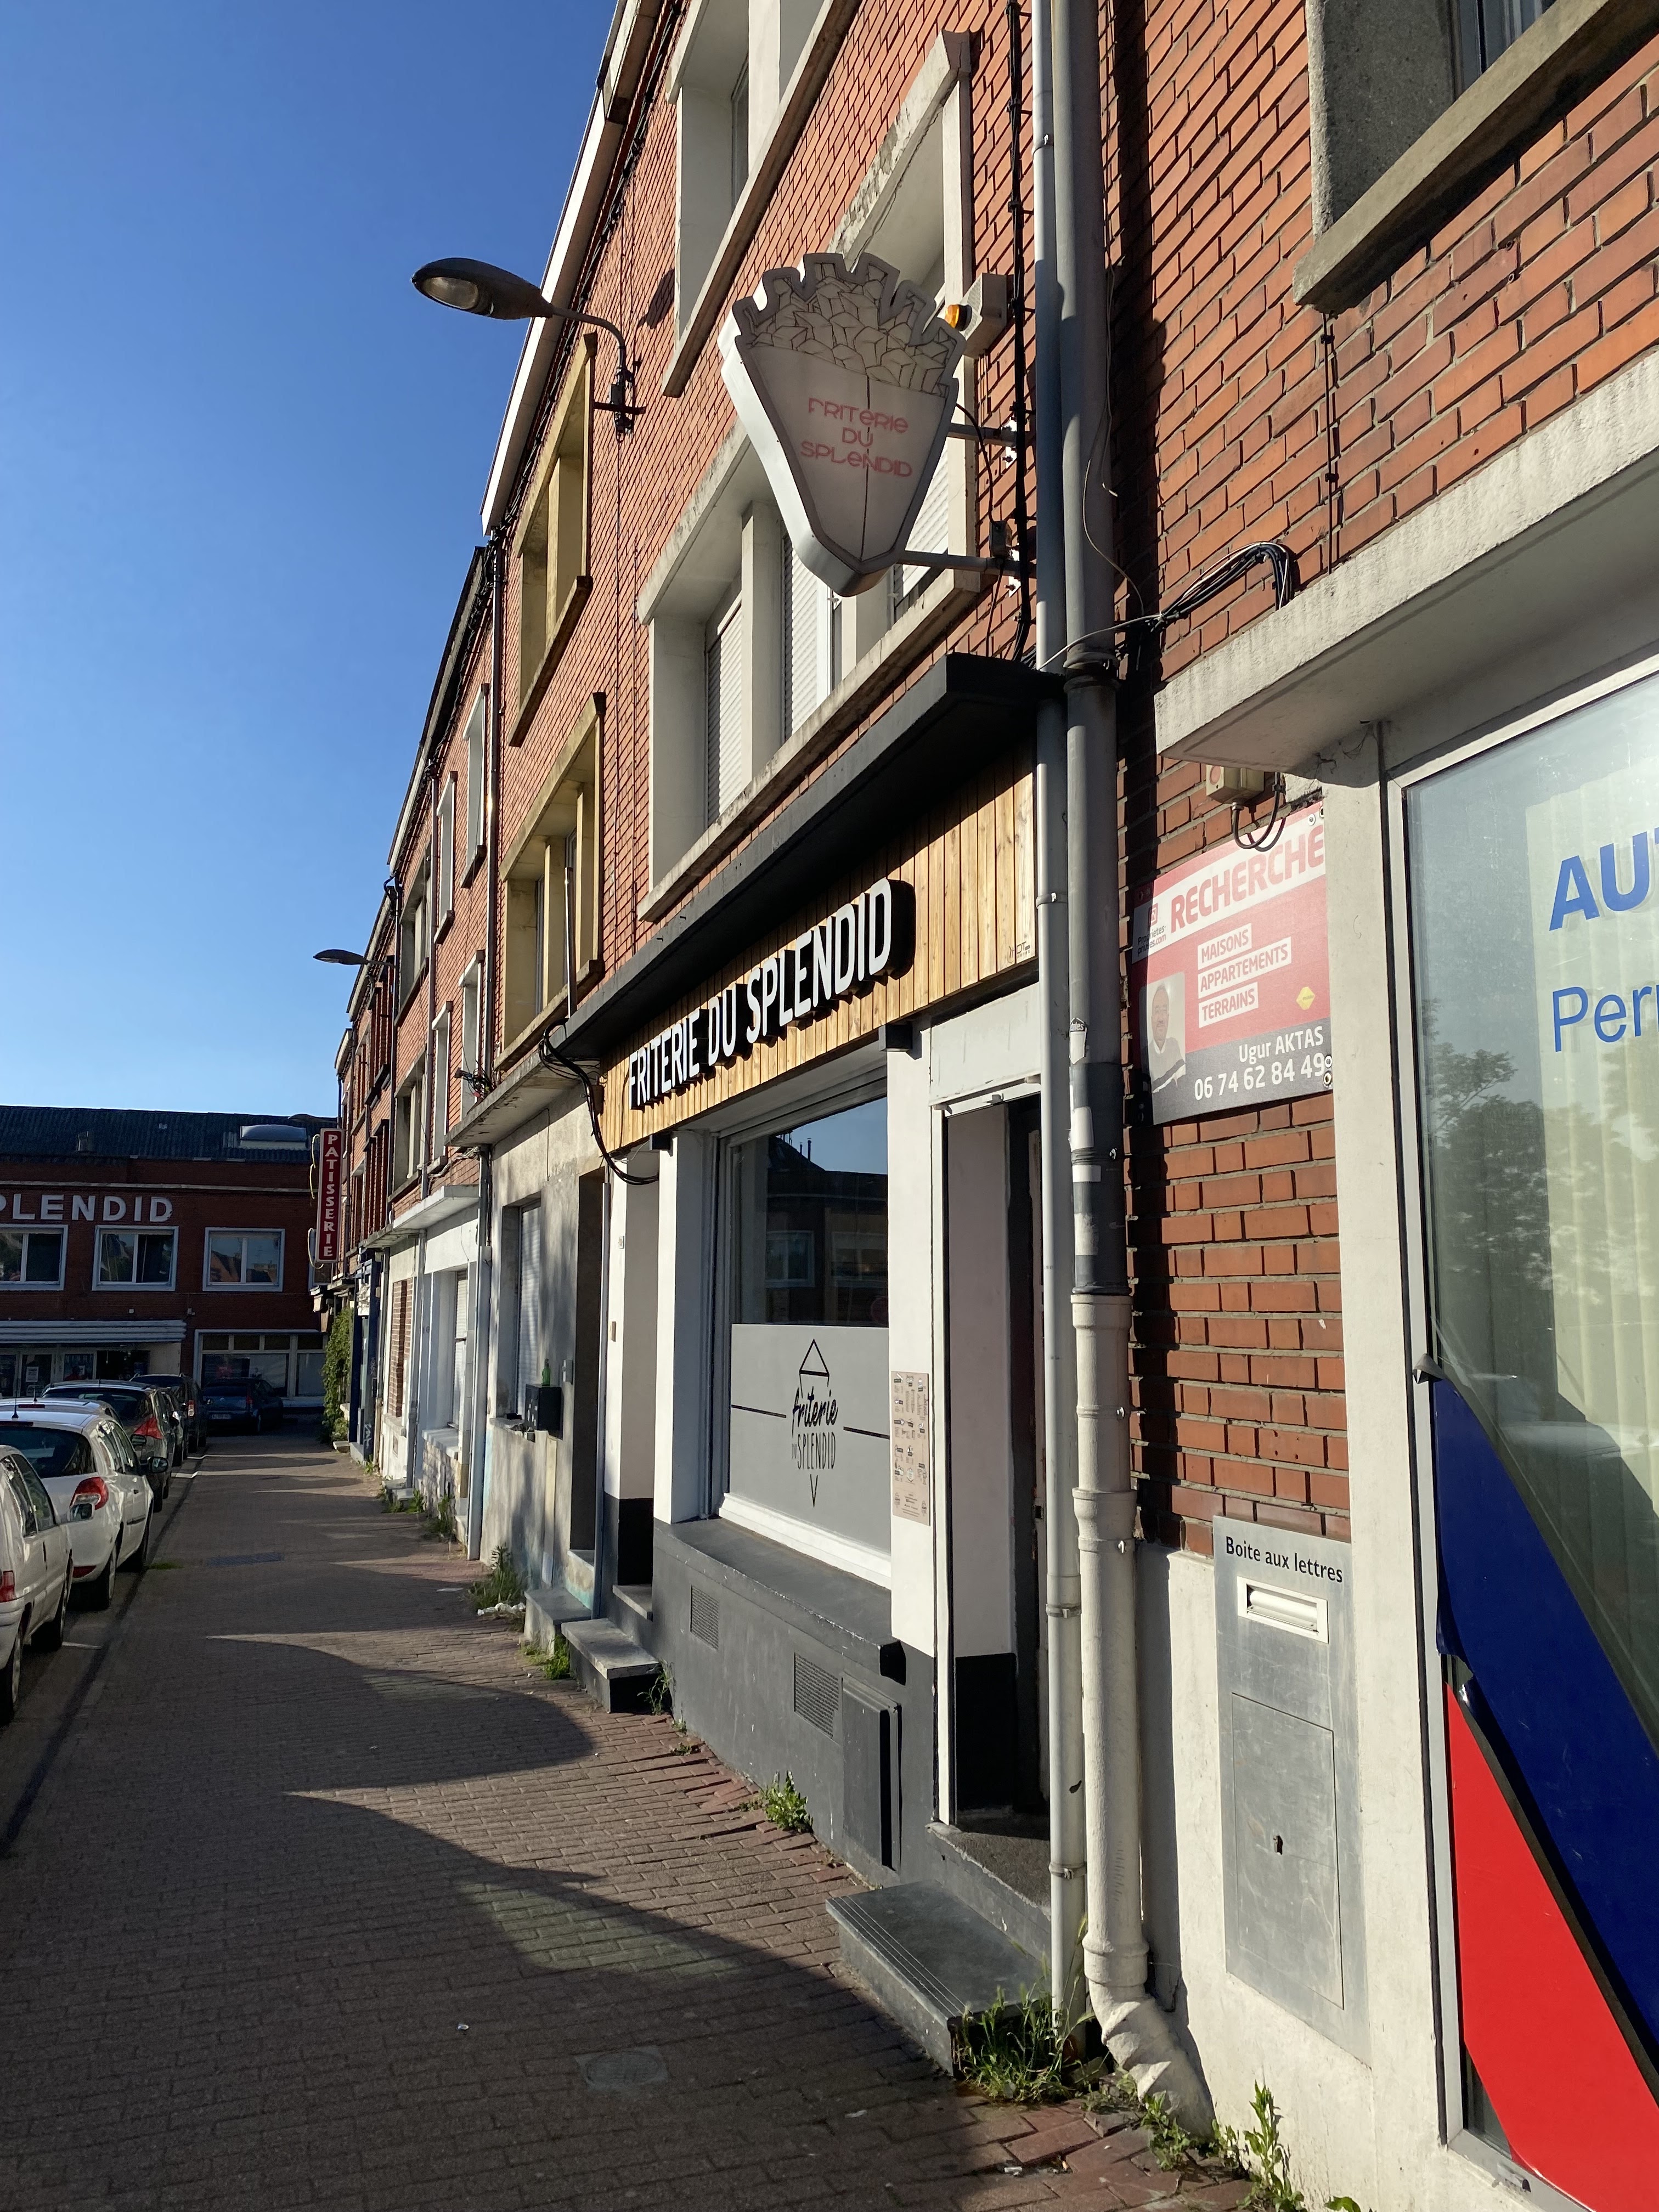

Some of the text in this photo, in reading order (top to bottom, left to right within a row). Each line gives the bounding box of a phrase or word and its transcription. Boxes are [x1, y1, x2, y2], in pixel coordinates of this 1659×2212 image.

[842, 427, 874, 447] DU
[1171, 824, 1324, 934] RECHERCHE
[1549, 827, 1659, 931] AU
[1200, 943, 1289, 992] APPARTEMENTS
[1201, 929, 1249, 963] MAISONS
[629, 877, 892, 1109] FRITERIE DU SPLENDID
[1202, 988, 1255, 1021] TERRAINS
[1553, 984, 1659, 1052] Per
[1239, 1026, 1324, 1065] Ugur AKTAS
[1194, 1052, 1325, 1100] 06 74 62 84 49
[323, 1134, 339, 1257] PATISSERIE
[797, 1431, 836, 1470] SPLENDID
[1226, 1536, 1343, 1583] Boite aux lettres
